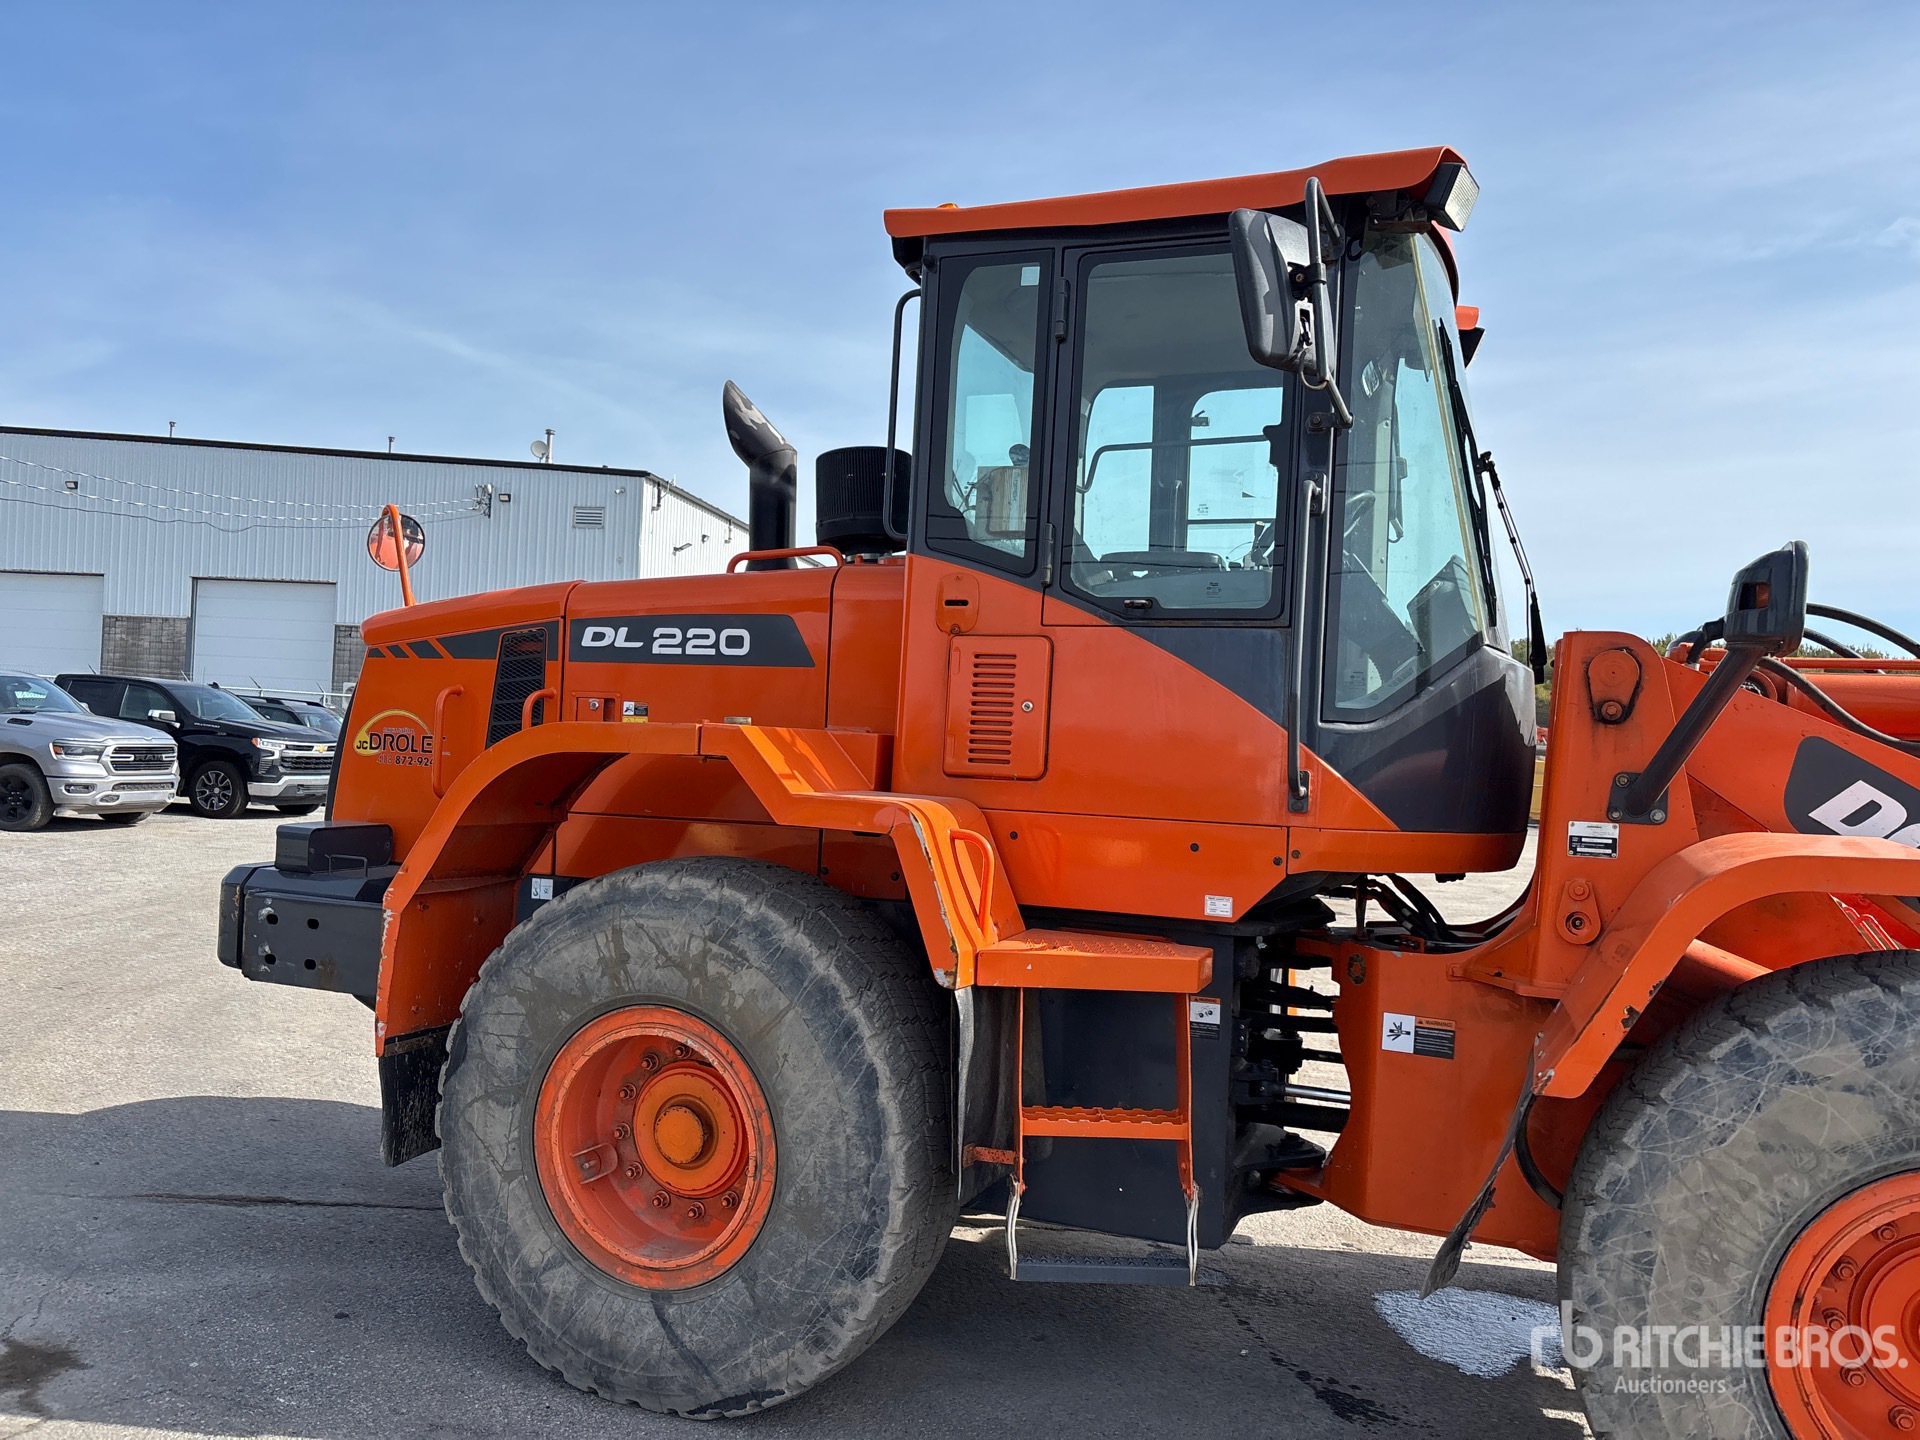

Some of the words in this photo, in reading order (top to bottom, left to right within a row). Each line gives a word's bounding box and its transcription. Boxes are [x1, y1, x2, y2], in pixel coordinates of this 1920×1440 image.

[581, 626, 644, 648] DL
[652, 627, 750, 656] 220
[369, 732, 446, 754] DROLE
